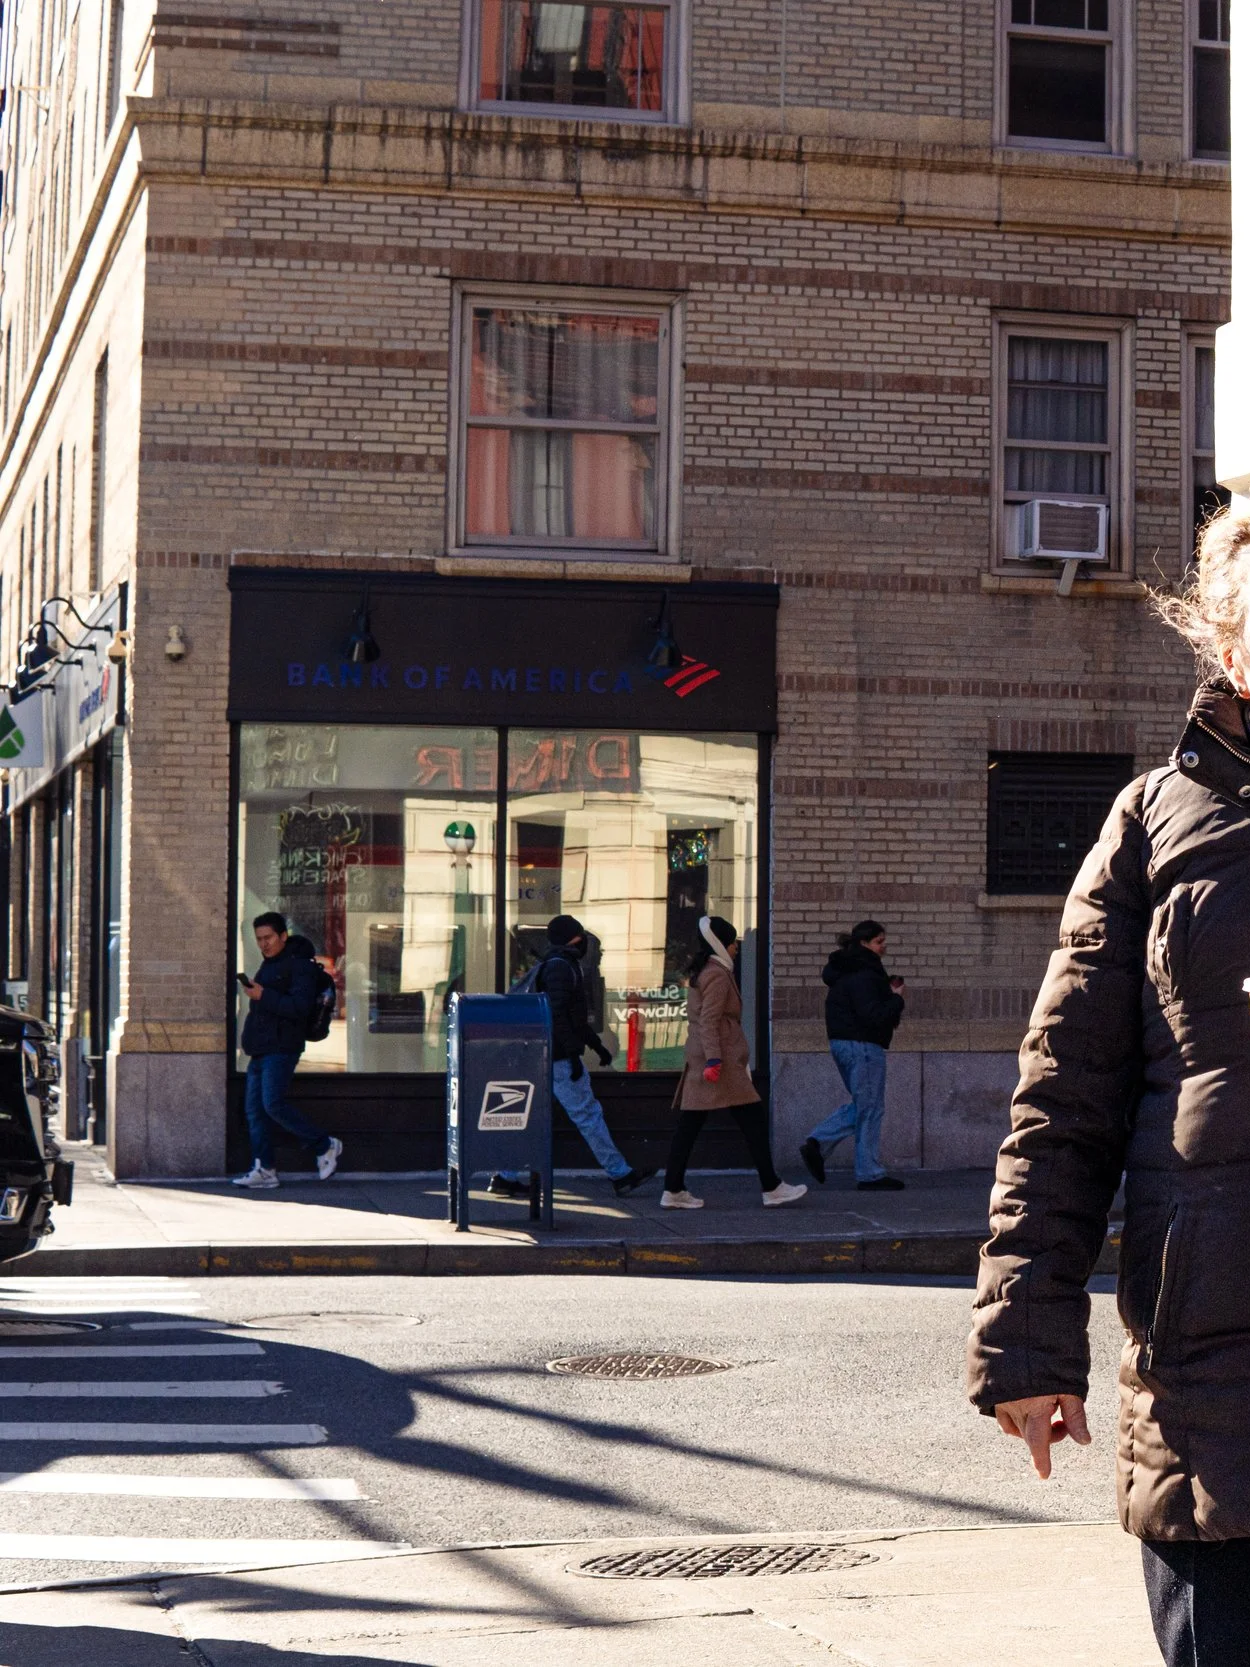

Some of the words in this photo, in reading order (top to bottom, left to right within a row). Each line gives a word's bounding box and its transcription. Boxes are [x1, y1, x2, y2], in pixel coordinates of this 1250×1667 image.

[287, 663, 392, 689] BANK
[403, 664, 451, 690] OF
[462, 666, 634, 695] AMERICA
